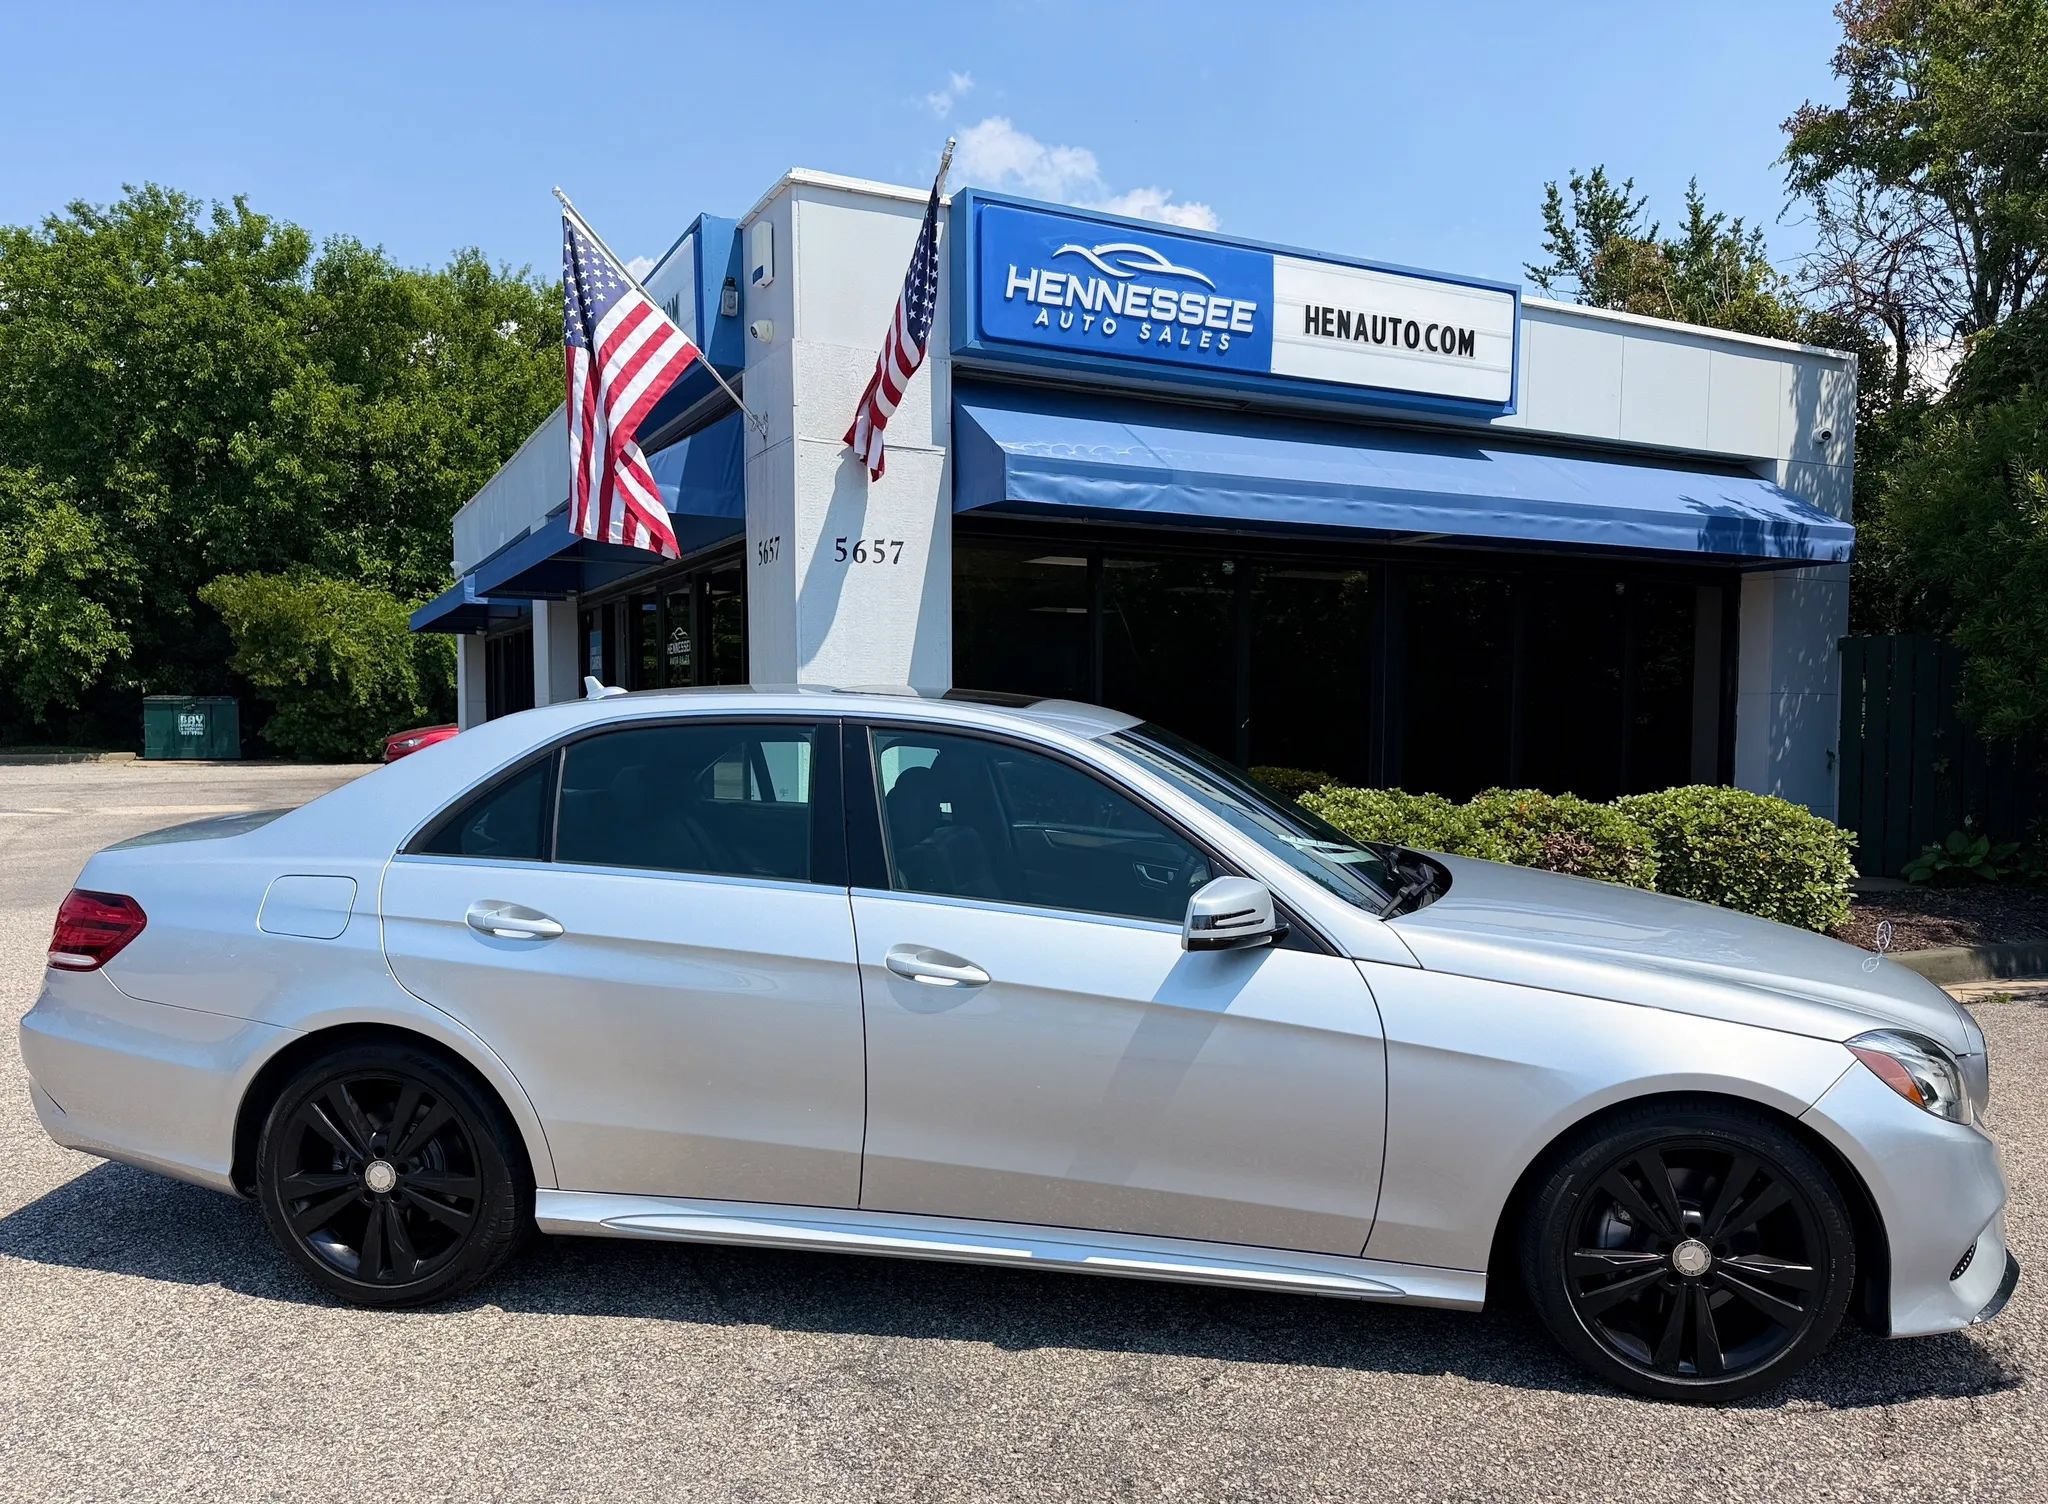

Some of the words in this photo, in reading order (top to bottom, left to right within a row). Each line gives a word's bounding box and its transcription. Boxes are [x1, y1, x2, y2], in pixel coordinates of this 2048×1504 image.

[1005, 264, 1257, 333] HENNESSEE
[1034, 307, 1117, 336] AUTO
[1138, 321, 1231, 351] SALES
[1305, 304, 1475, 358] HENAUTO.COM
[758, 535, 781, 567] 5657
[834, 535, 905, 566] 5657
[180, 715, 203, 724] BAY
